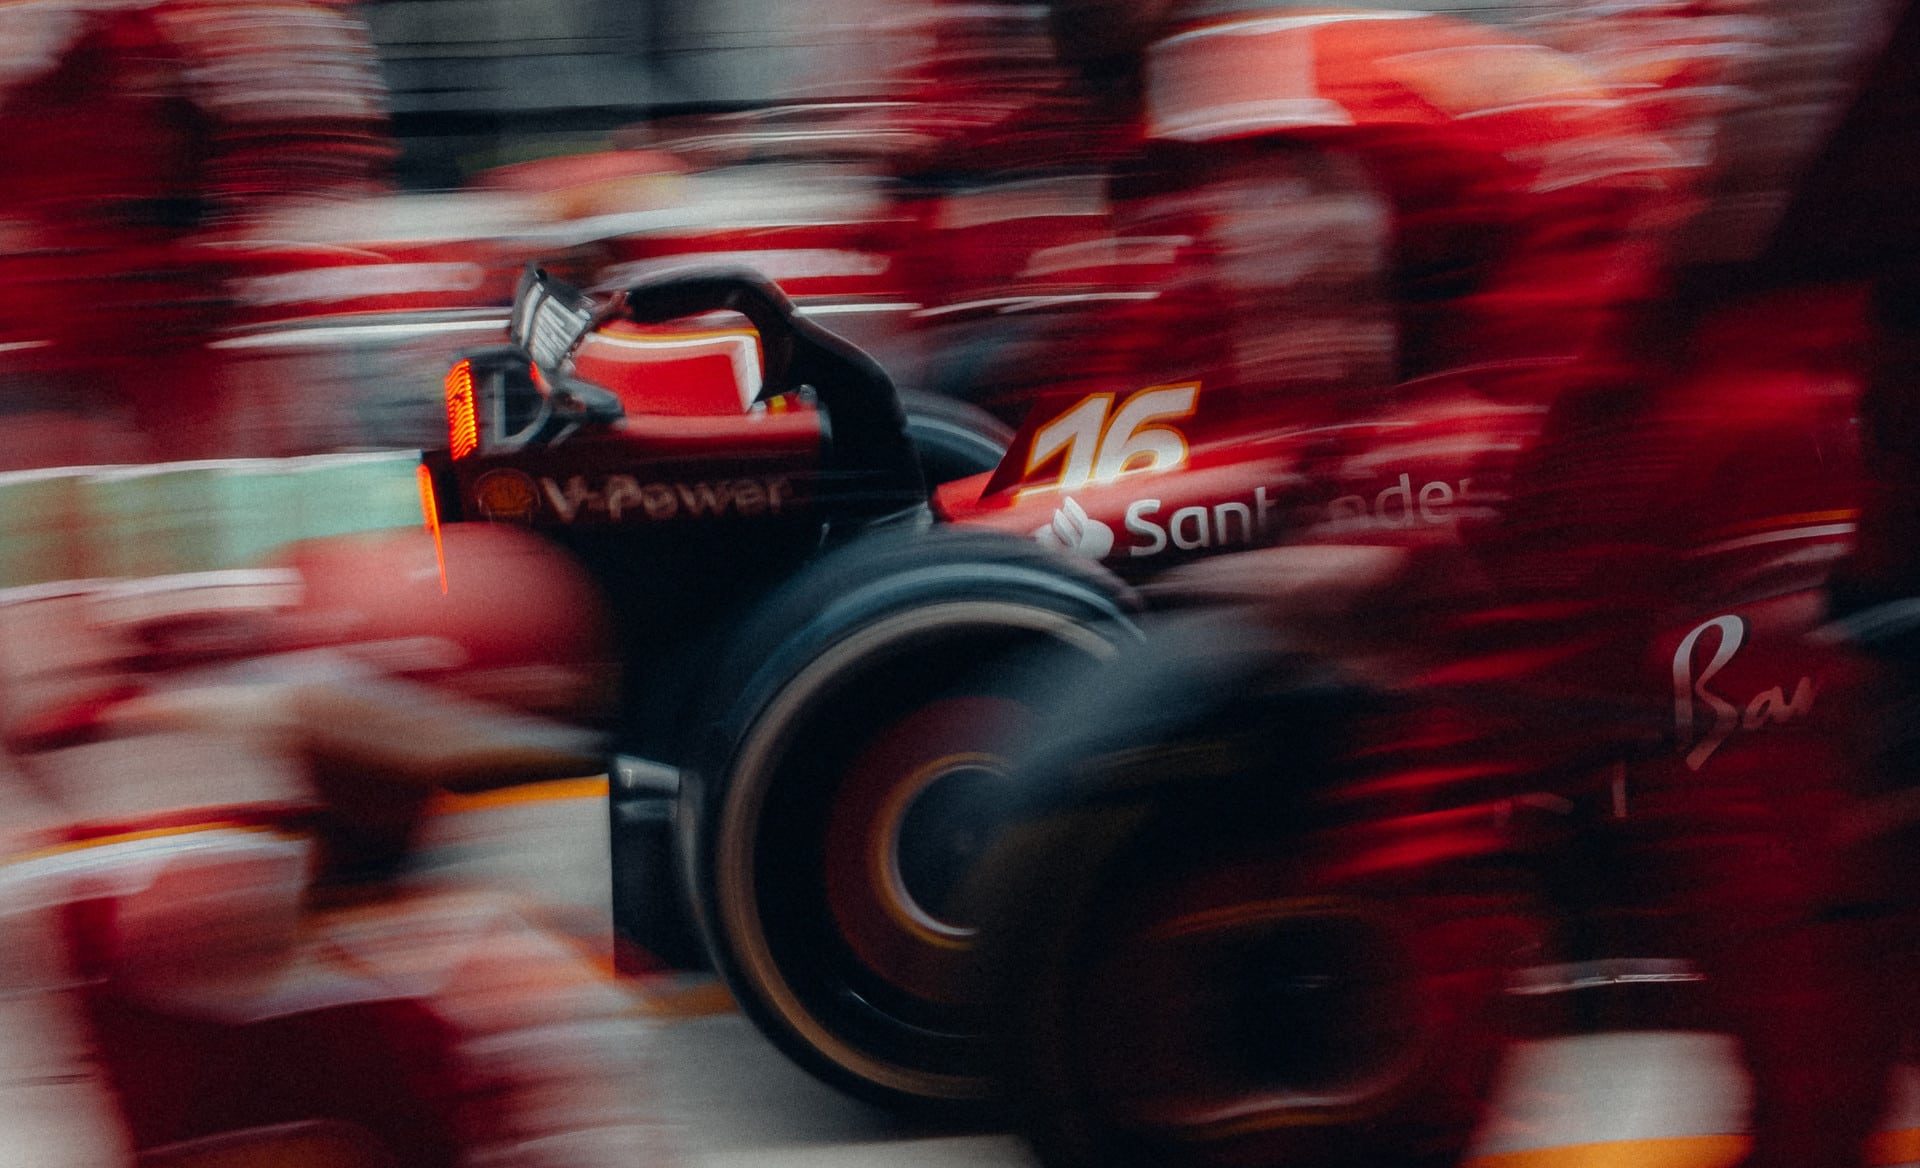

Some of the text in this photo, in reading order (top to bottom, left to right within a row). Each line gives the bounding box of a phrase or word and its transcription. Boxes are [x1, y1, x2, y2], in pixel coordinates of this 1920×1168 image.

[1024, 380, 1202, 491] 16
[540, 473, 794, 526] V-Power
[1124, 473, 1470, 557] Santnde
